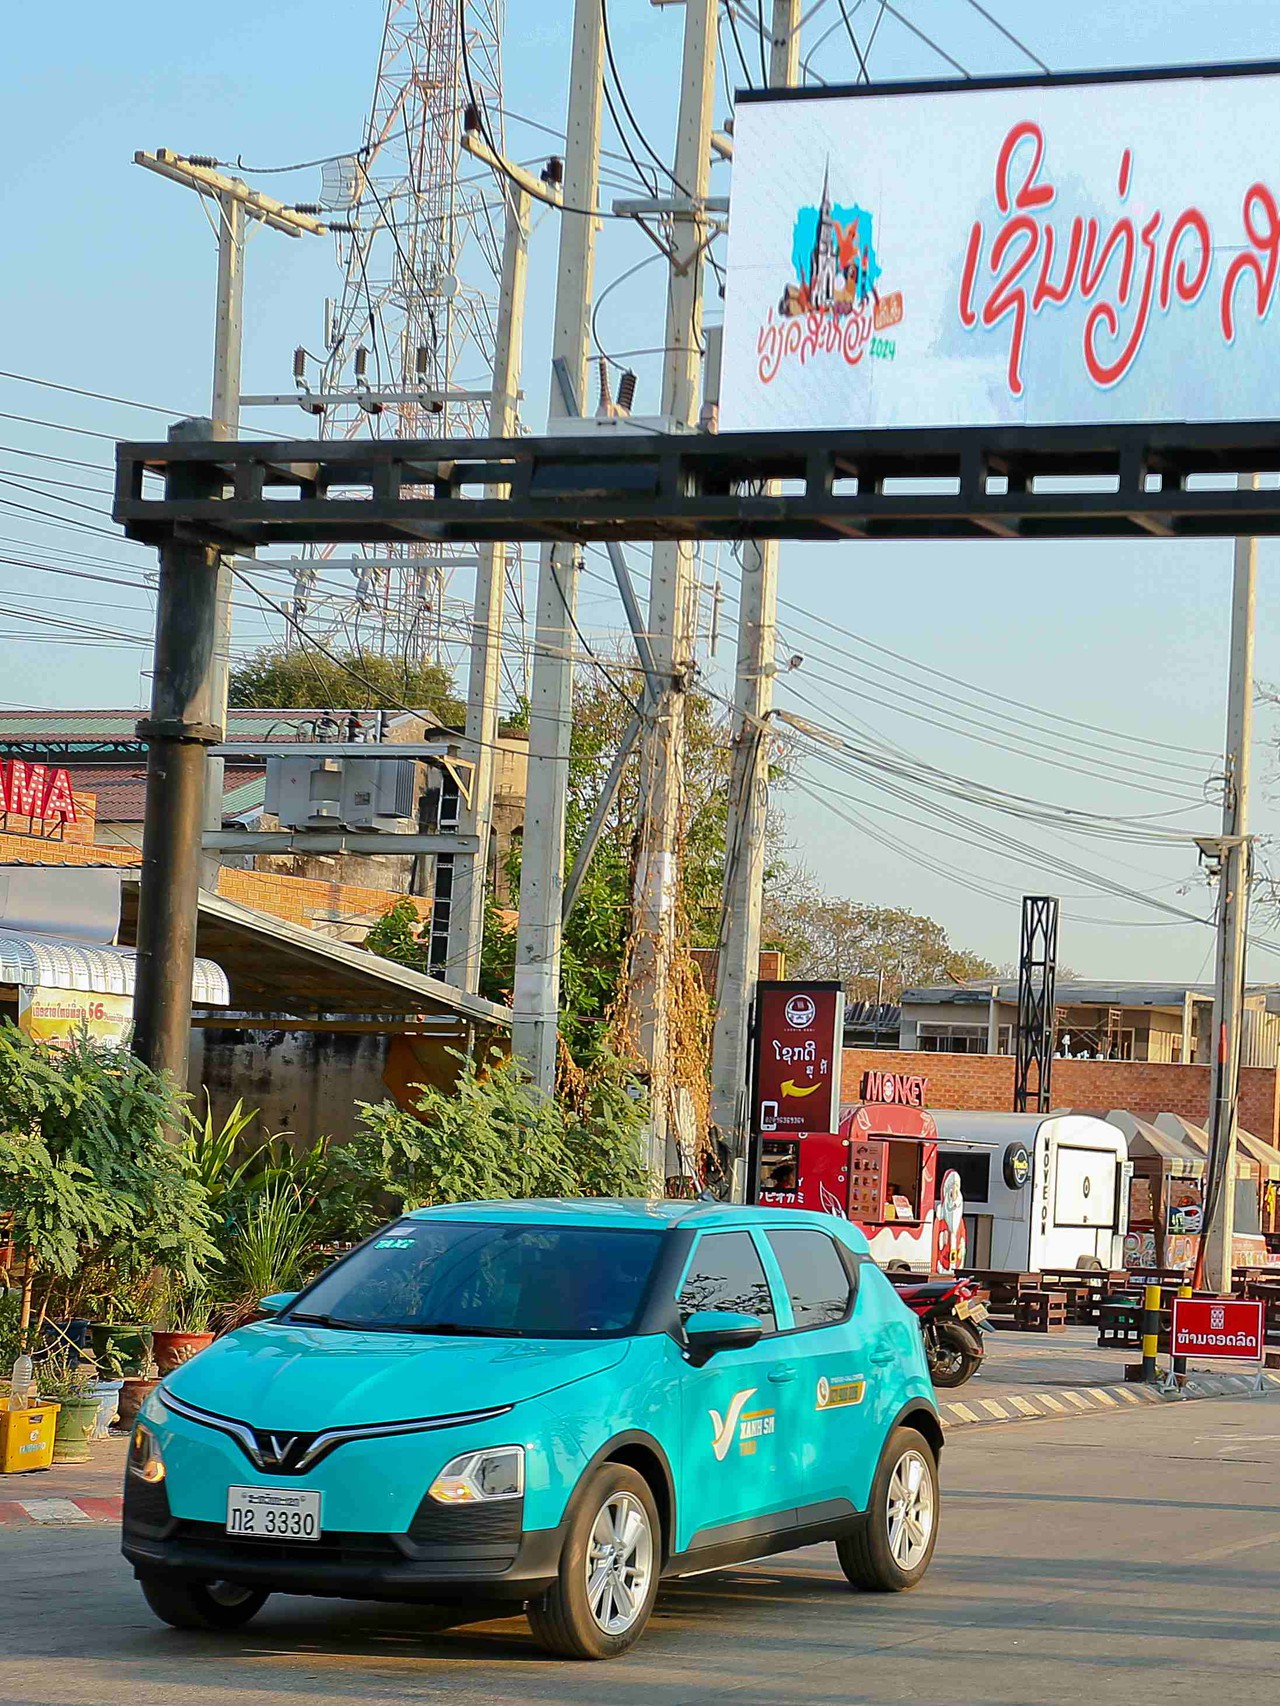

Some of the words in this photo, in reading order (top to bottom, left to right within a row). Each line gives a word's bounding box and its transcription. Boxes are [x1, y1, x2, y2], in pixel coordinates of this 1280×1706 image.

[869, 337, 896, 361] 2024
[866, 1070, 928, 1106] MONKEY
[265, 1510, 314, 1536] 3330
